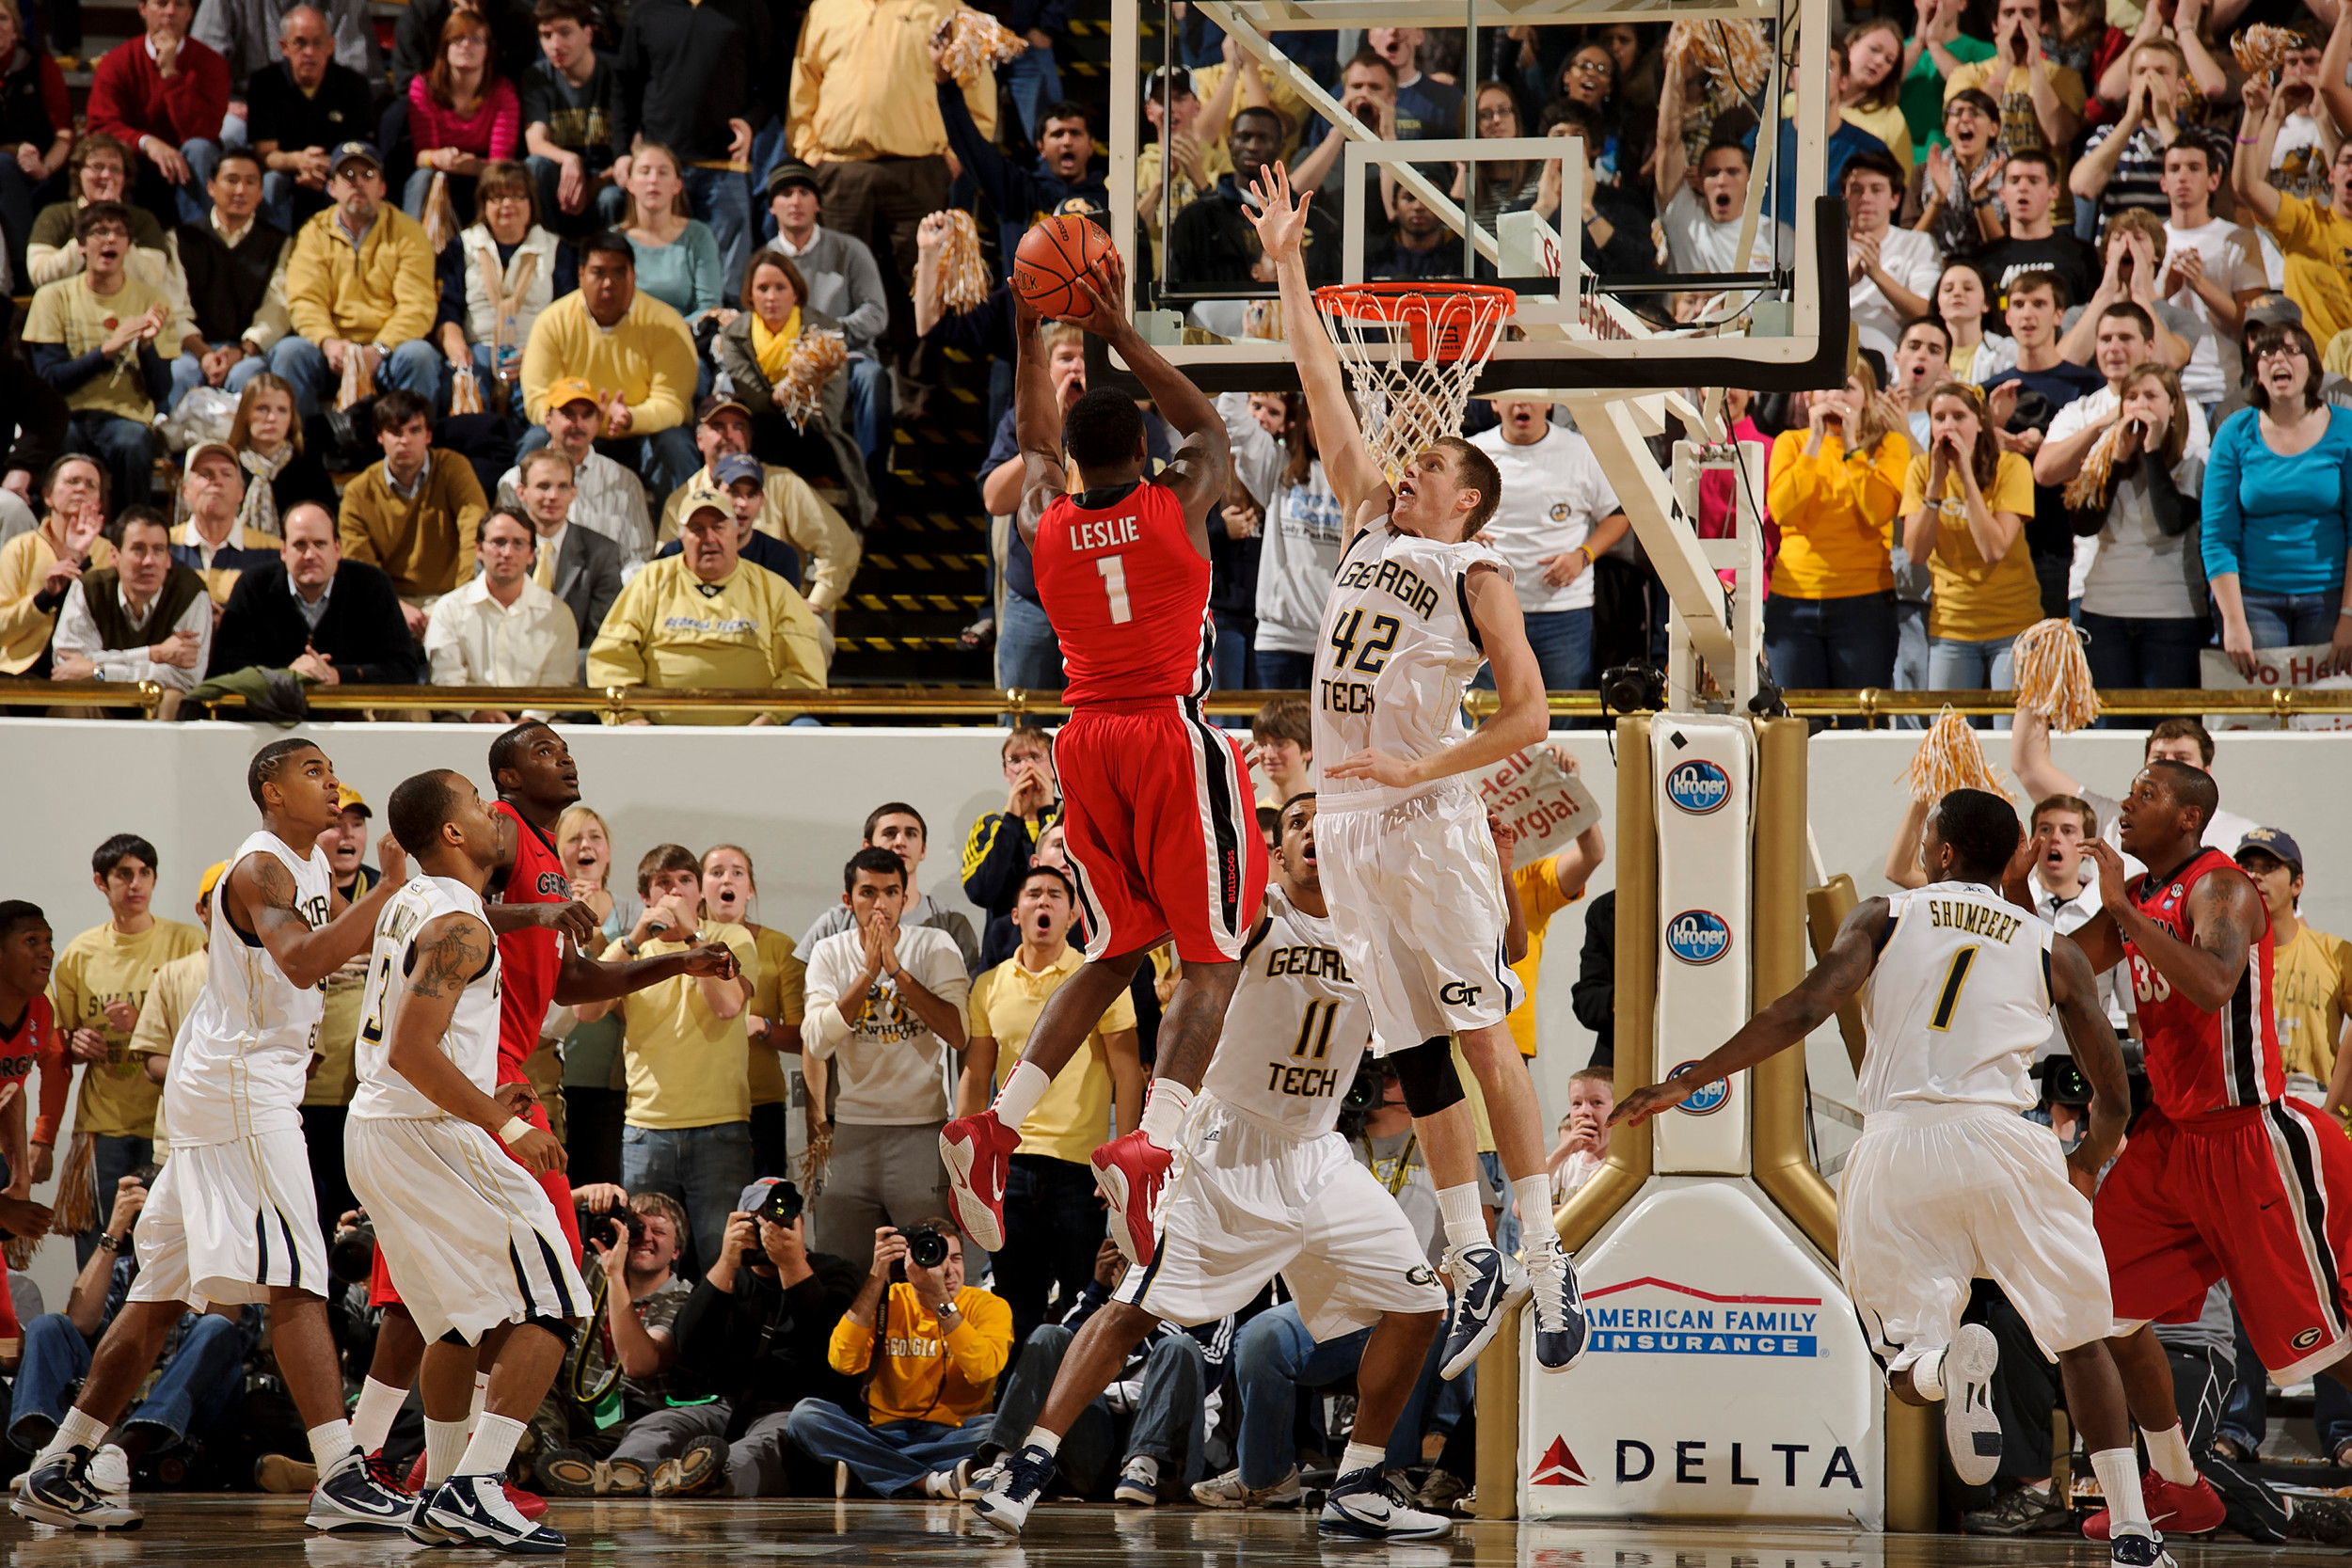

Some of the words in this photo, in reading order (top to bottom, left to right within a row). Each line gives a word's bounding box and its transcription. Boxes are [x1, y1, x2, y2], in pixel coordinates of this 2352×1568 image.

[1070, 515, 1140, 551] LESLIE
[1096, 554, 1133, 626] 1
[1331, 607, 1403, 676] 42
[1320, 678, 1375, 715] TECH
[1673, 766, 1725, 807] Kroger
[1227, 849, 1236, 903] BULLDOGS
[1673, 916, 1725, 958] Kroger
[1930, 900, 2022, 944] SHUMPERT
[1439, 980, 1483, 1007] GT
[1927, 943, 1980, 1032] 1
[1291, 997, 1341, 1060] 11
[1267, 1062, 1340, 1098] TECH
[1406, 1263, 1441, 1287] GT
[1584, 1308, 1713, 1330] AMERICAN
[1725, 1311, 1817, 1333] FAMILY
[1597, 1334, 1799, 1354] INSURANCE
[1615, 1439, 1864, 1489] DELTA
[2150, 1543, 2157, 1556] IS
